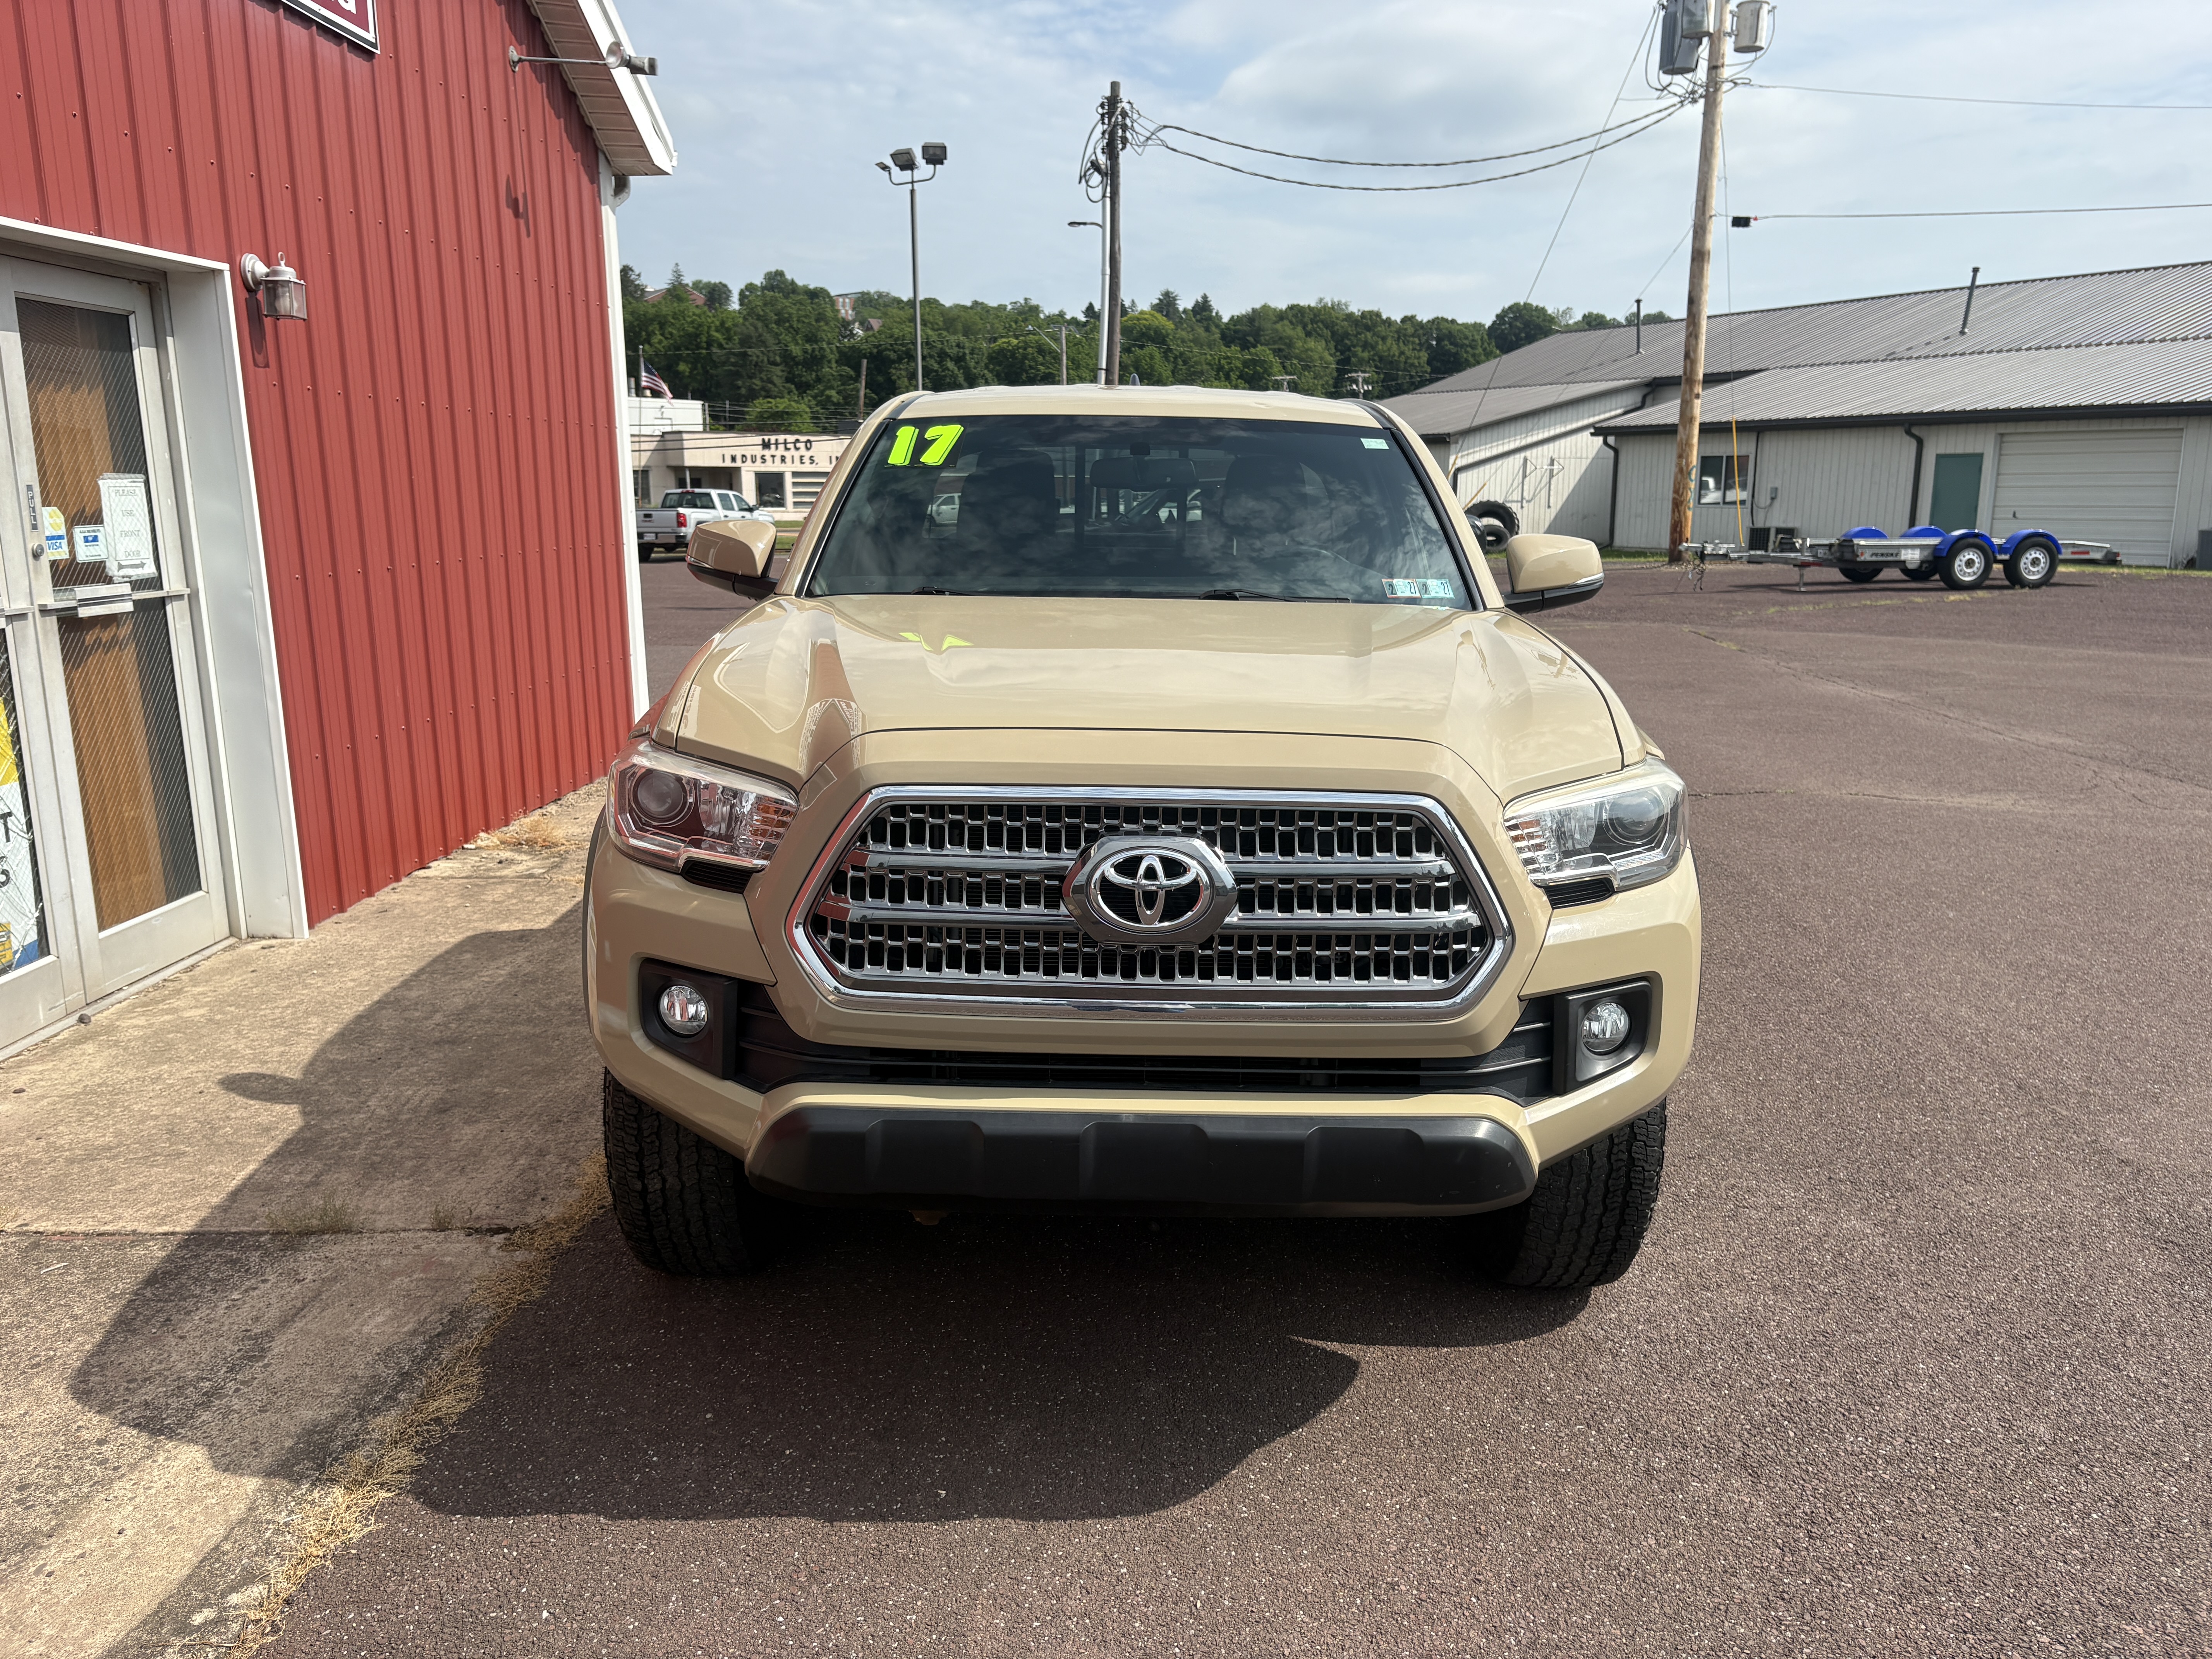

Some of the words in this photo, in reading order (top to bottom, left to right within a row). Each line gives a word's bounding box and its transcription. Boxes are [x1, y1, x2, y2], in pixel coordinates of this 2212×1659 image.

[762, 438, 812, 451] MILCO
[888, 424, 963, 465] 17
[722, 453, 819, 465] INDUSTRIES,
[28, 491, 36, 524] PULL
[120, 529, 141, 538] FRONT
[47, 541, 63, 551] VISA
[1408, 582, 1416, 594] 27
[1441, 582, 1450, 595] 27
